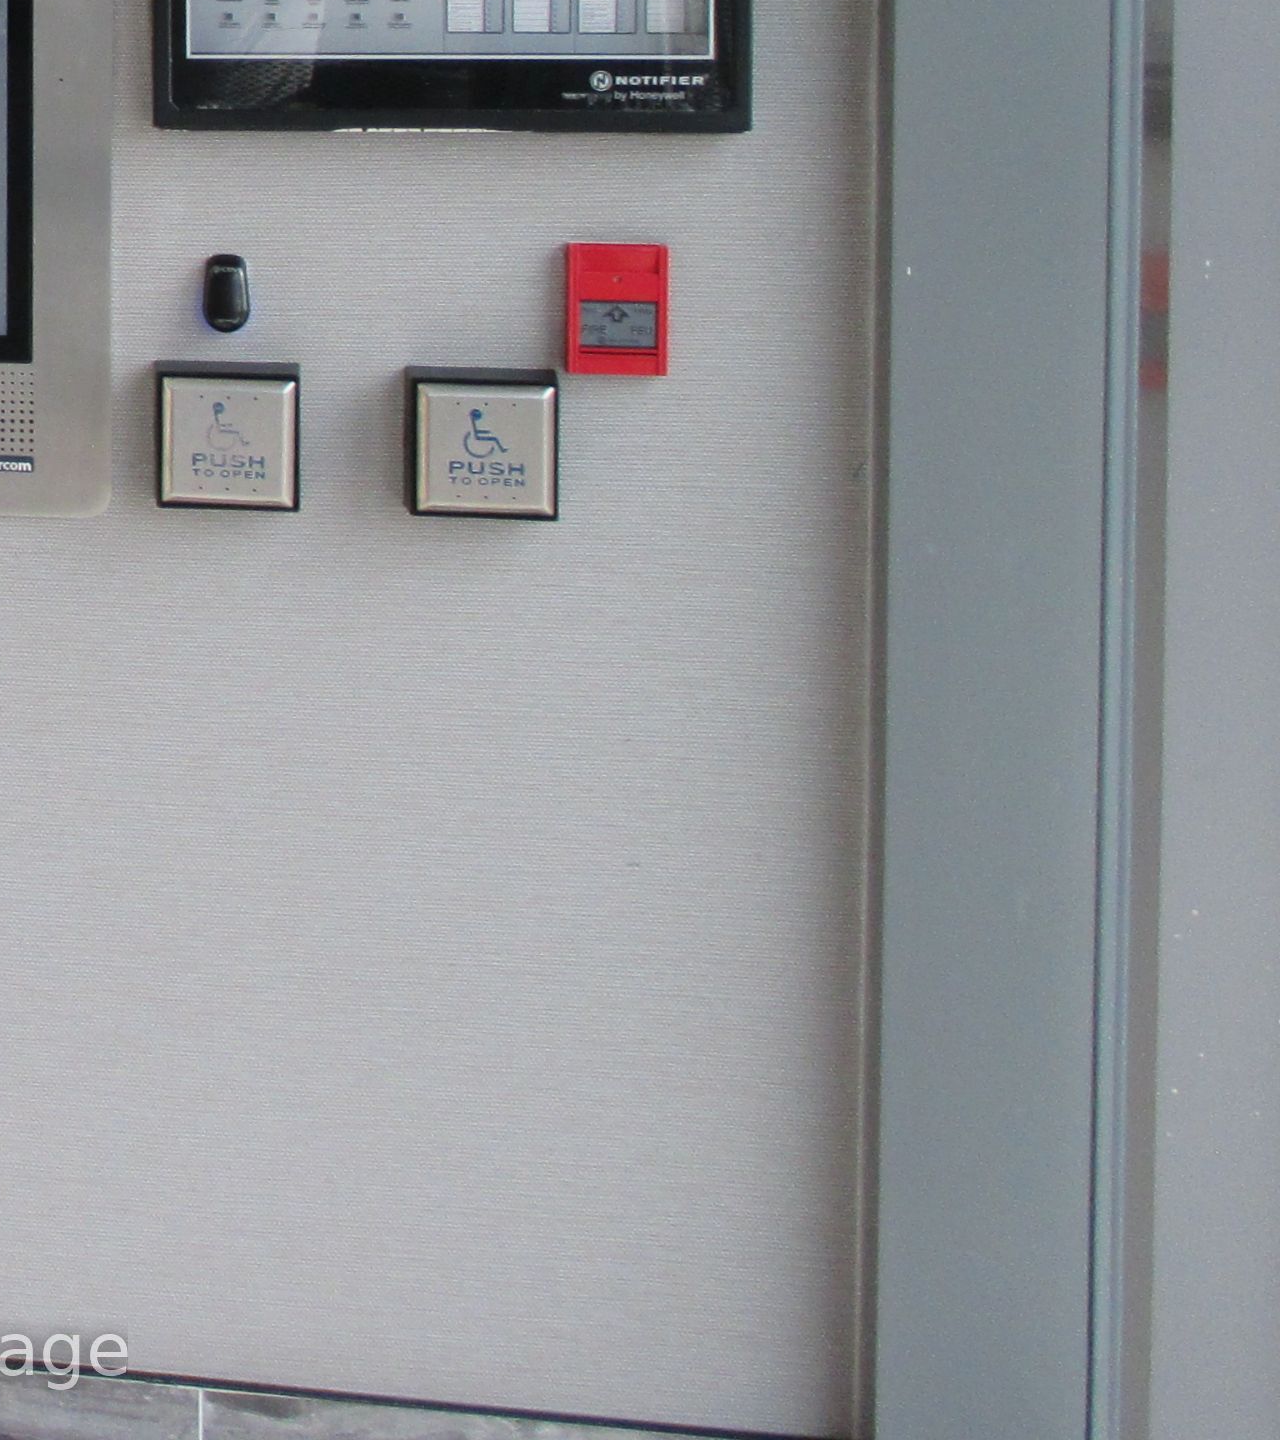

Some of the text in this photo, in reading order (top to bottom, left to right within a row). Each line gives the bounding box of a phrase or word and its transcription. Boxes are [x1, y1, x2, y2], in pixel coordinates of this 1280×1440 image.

[615, 75, 705, 86] NOTIFIER
[614, 90, 686, 102] by Honeywell
[192, 453, 265, 470] PUSH
[192, 468, 266, 480] TO OPEN
[449, 461, 525, 477] PUSH
[449, 476, 525, 487] TO OPEN
